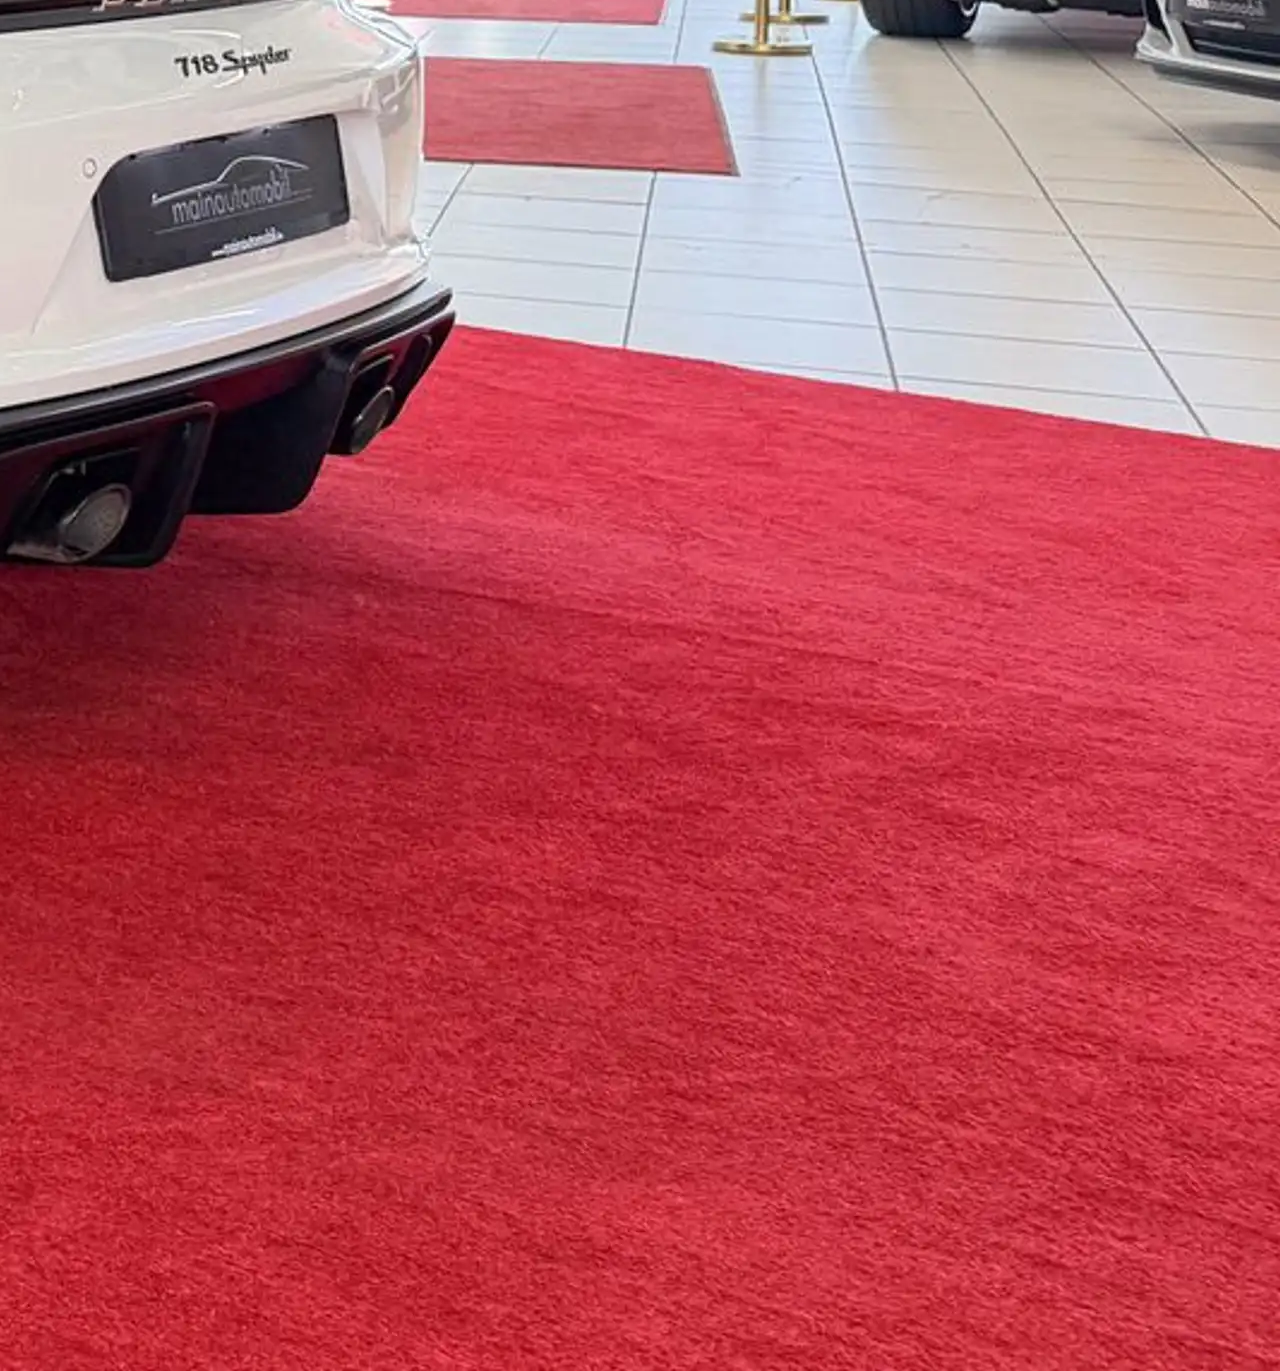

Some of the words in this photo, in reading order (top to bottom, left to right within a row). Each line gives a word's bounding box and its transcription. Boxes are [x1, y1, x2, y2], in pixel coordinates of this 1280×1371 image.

[173, 54, 220, 78] 718
[221, 44, 292, 76] Spyder
[171, 163, 291, 224] mainautomobil
